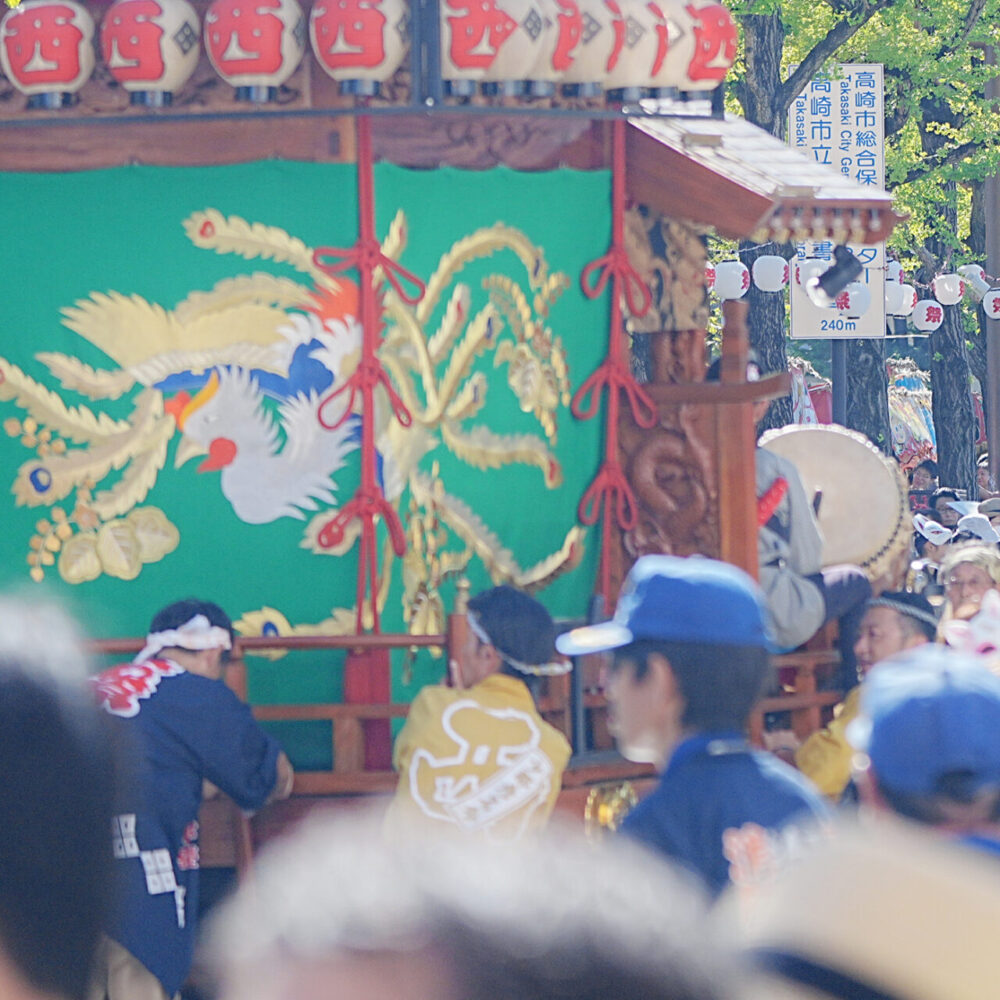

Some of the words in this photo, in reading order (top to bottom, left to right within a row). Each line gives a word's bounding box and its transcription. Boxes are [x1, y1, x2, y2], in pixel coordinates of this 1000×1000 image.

[796, 93, 807, 147] Takasaki
[840, 75, 852, 126] Takasaki
[839, 130, 852, 152] City
